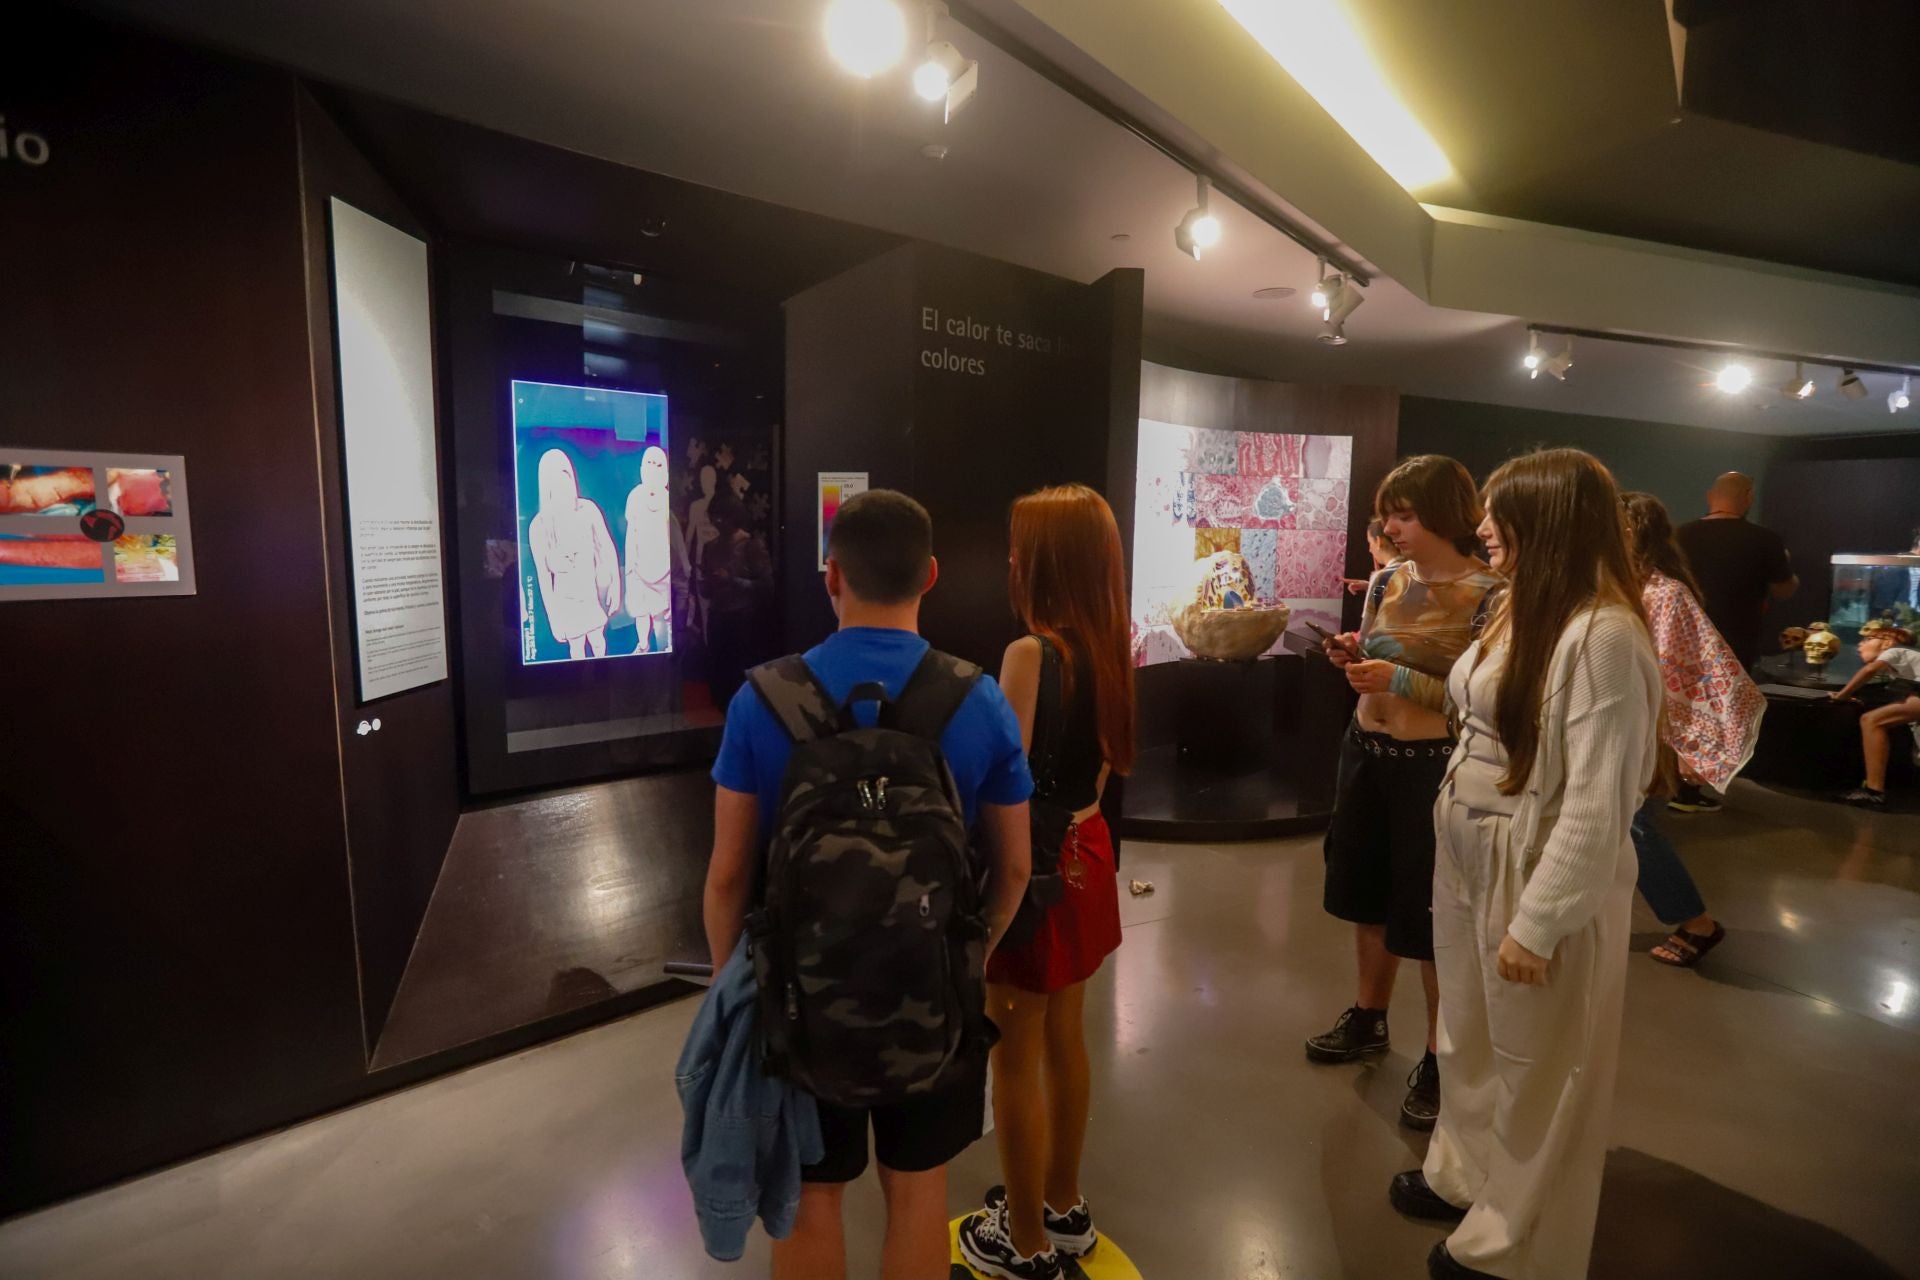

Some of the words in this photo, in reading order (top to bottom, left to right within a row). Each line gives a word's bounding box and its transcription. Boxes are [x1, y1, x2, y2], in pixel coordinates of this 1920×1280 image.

[922, 306, 939, 332] El
[946, 316, 990, 342] calor
[996, 324, 1013, 347] te
[1017, 333, 1052, 354] saca
[920, 347, 985, 376] colores
